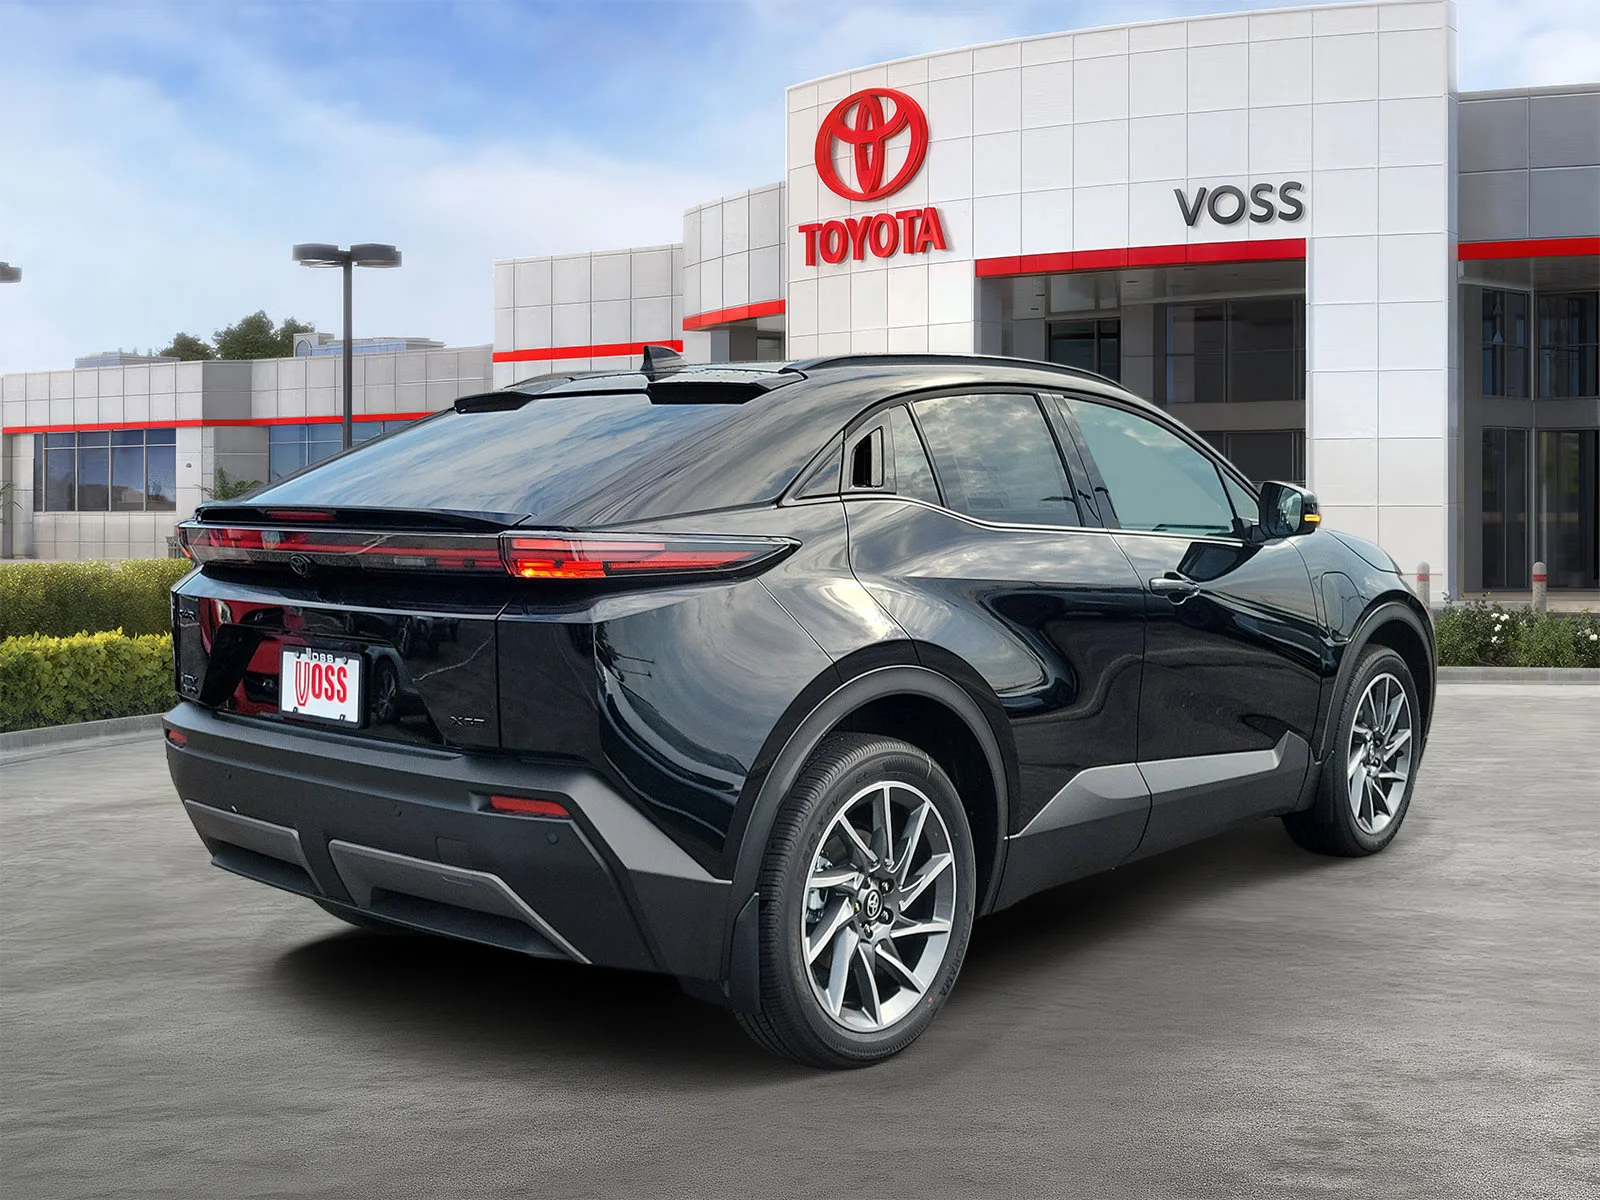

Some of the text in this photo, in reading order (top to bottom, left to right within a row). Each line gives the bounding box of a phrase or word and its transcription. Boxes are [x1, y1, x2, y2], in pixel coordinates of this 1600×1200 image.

[1173, 181, 1303, 226] VOSS
[798, 207, 946, 266] TOYOTA
[295, 661, 348, 707] VOSS
